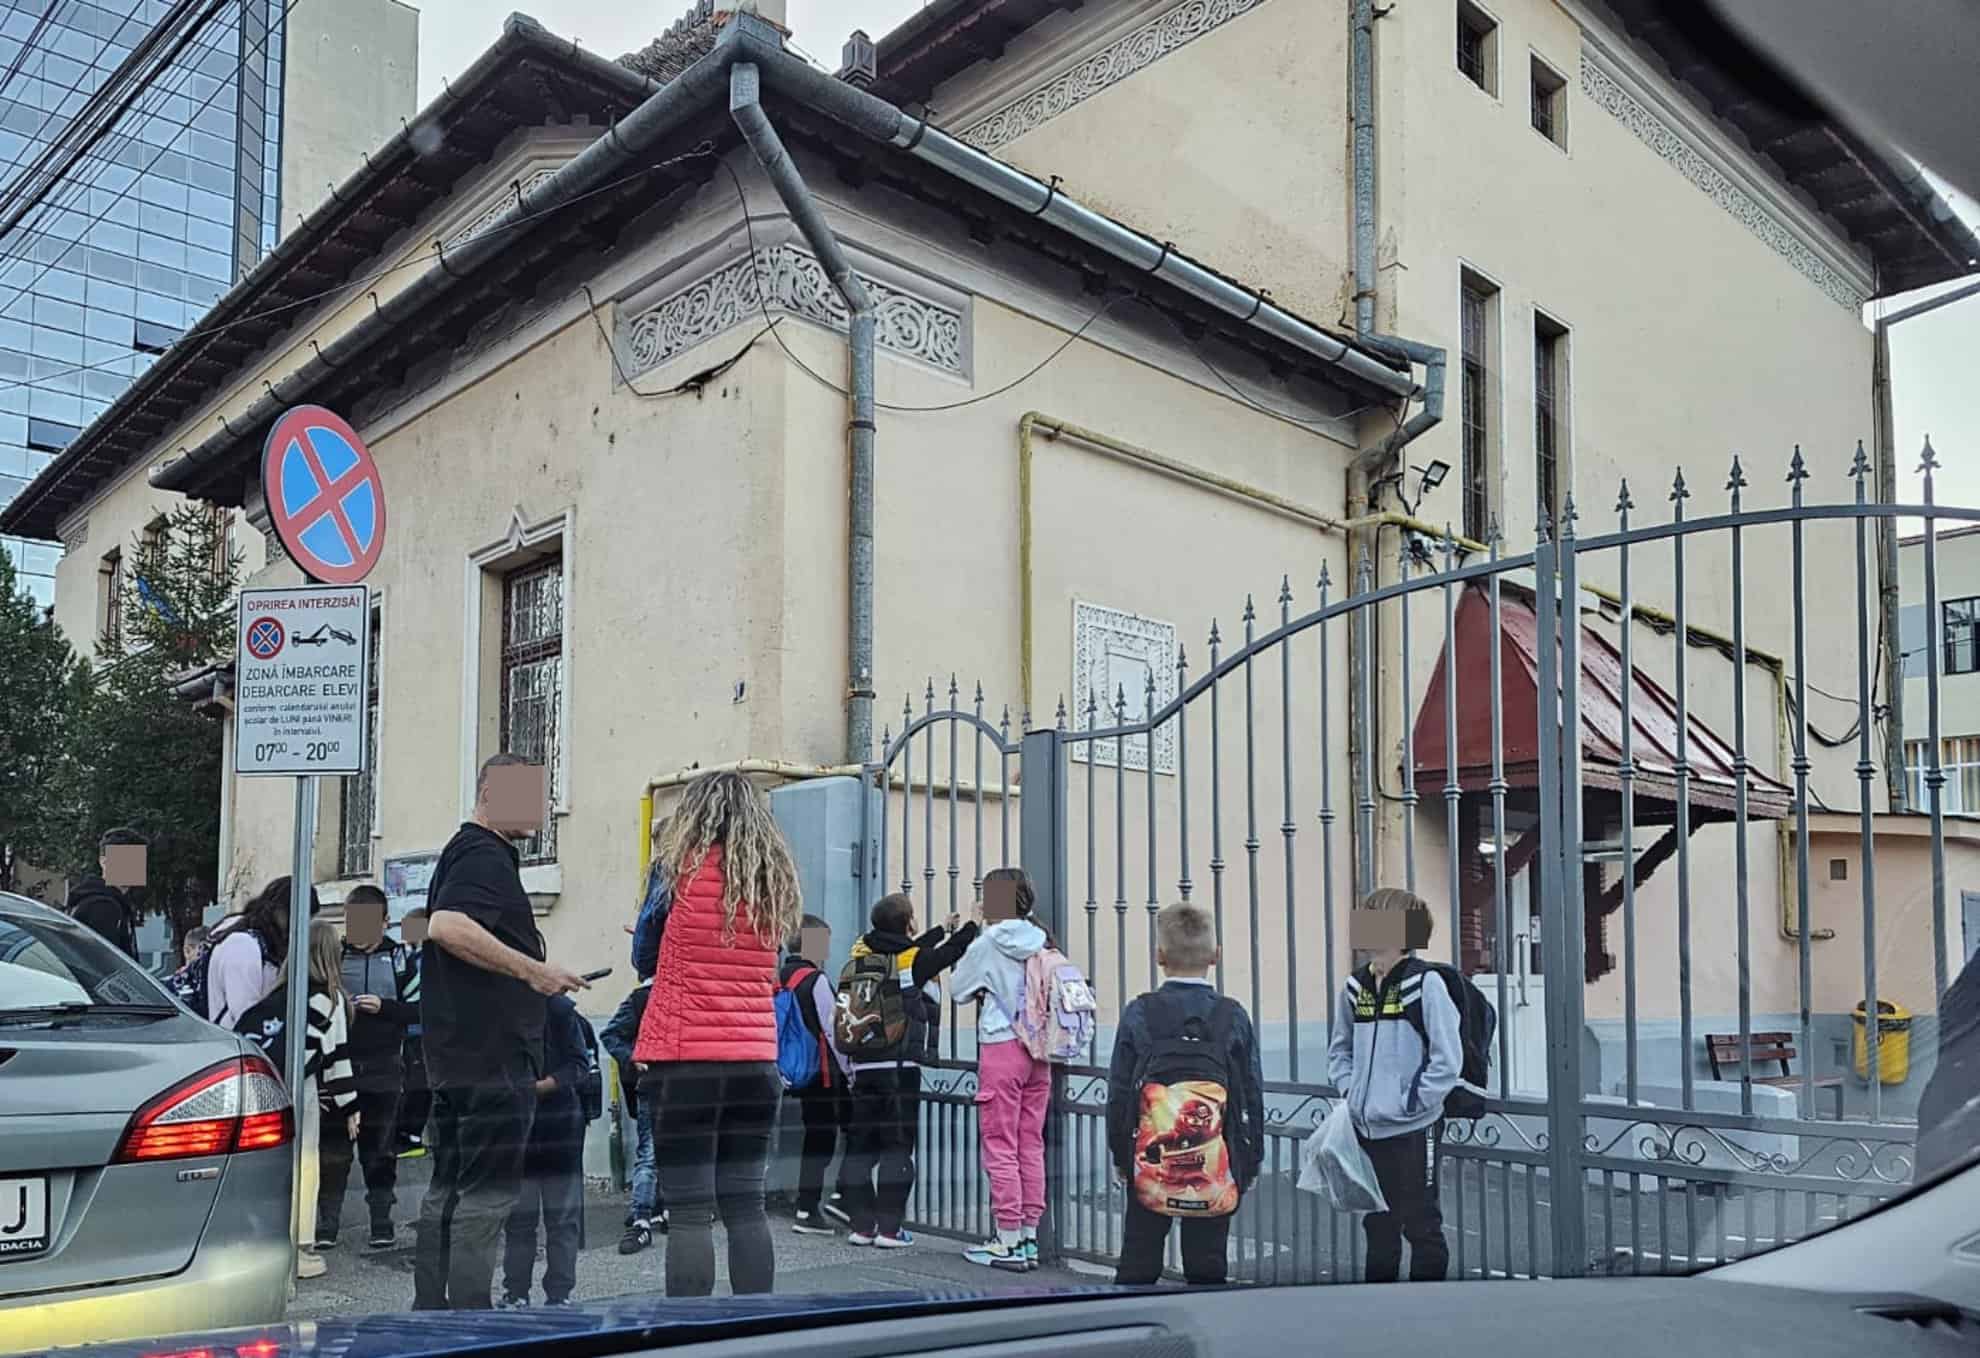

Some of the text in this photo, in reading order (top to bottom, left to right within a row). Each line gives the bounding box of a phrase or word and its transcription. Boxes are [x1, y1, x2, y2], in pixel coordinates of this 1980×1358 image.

[247, 594, 360, 611] OPRIREA INTERZISĂ!
[245, 663, 356, 681] ZONĂ ÎMBARCARE
[242, 682, 358, 698] DEBARCARE ELEVI
[0, 1240, 43, 1252] DACIA
